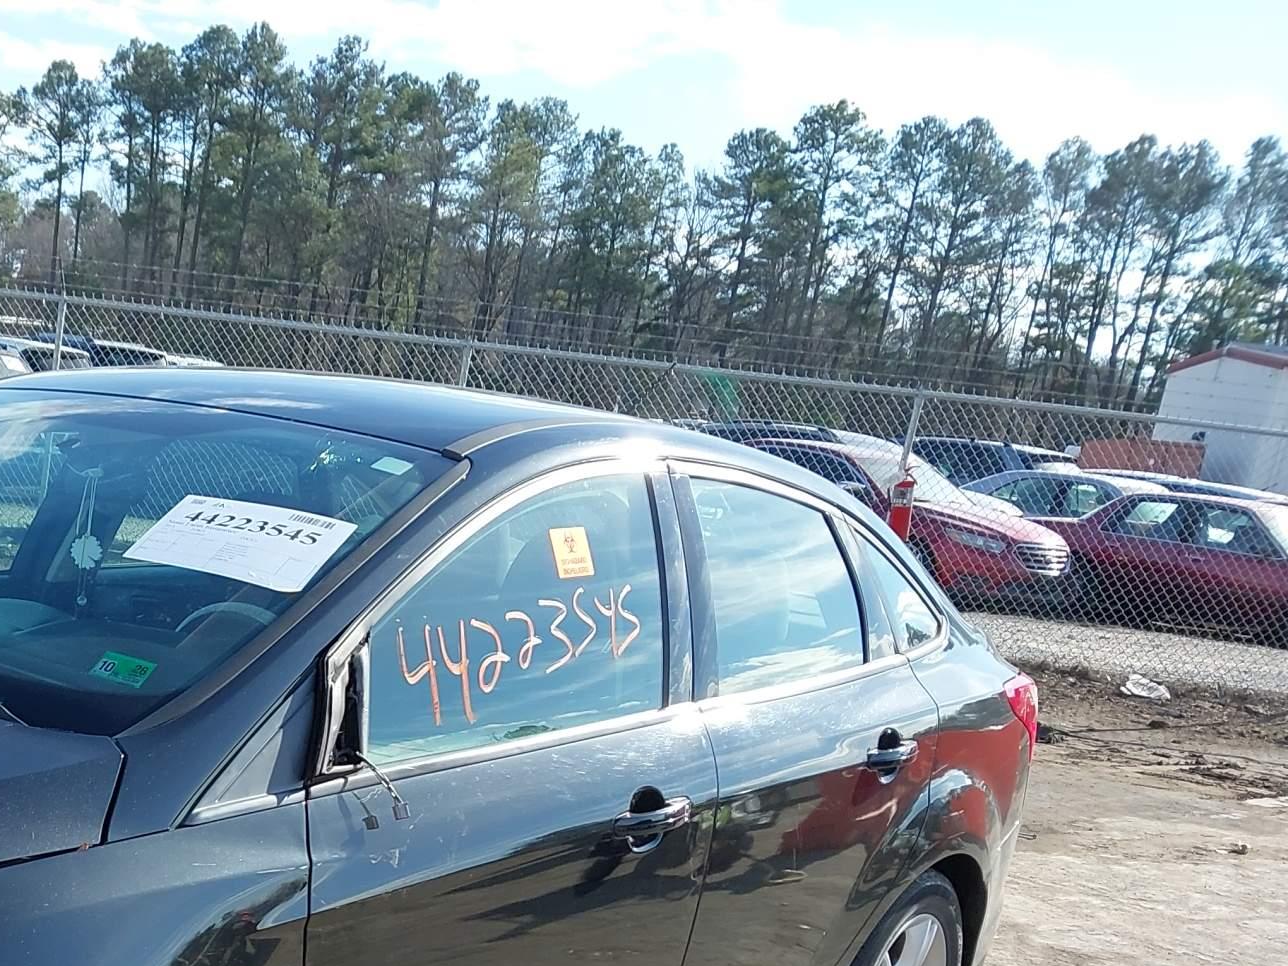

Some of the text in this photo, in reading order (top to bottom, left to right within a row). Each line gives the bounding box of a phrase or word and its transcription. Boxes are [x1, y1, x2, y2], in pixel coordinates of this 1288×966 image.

[184, 511, 325, 545] 44223545
[98, 660, 116, 673] 10
[396, 584, 642, 727] 44223545
